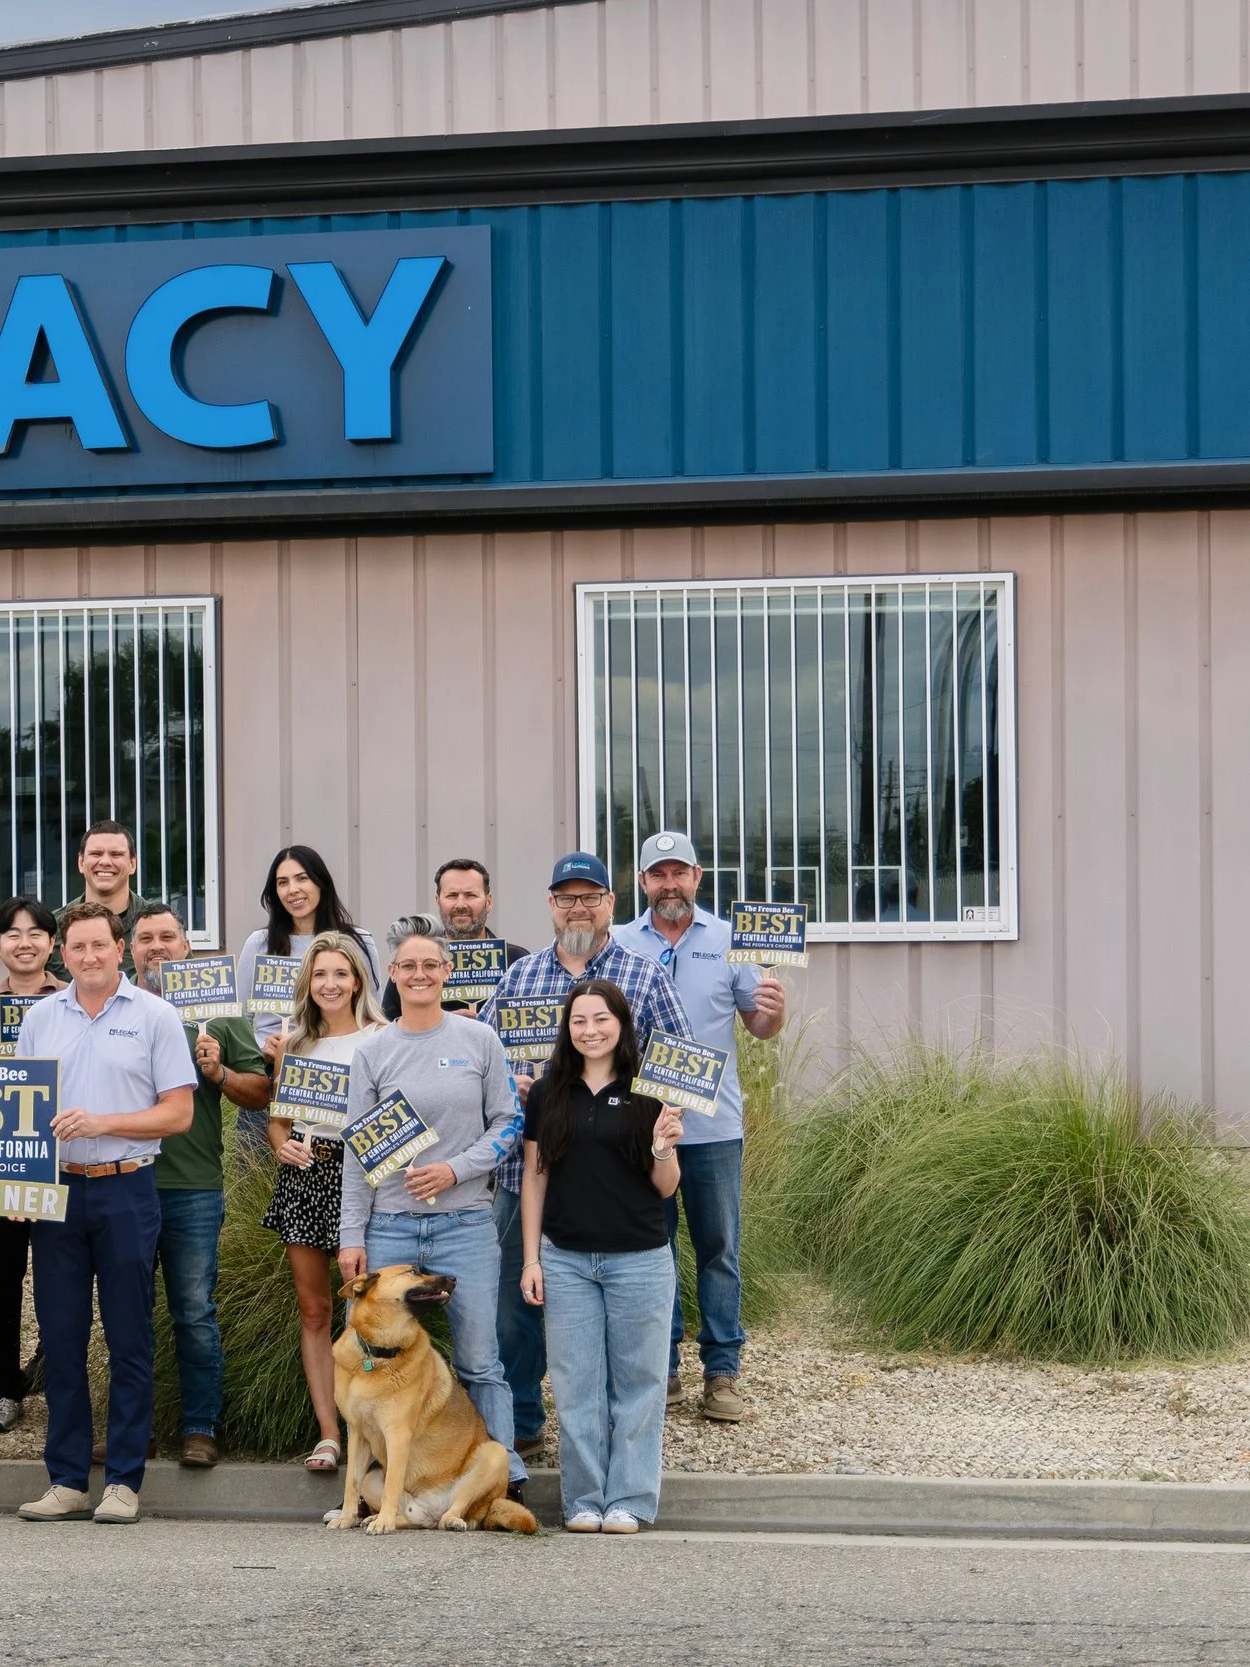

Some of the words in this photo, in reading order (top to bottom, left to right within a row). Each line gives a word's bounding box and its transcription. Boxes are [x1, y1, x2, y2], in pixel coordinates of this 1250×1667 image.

[735, 912, 803, 935] BEST
[743, 934, 767, 942] CENTRAL
[769, 935, 802, 944] CALIFORNIA
[730, 952, 757, 962] 2026
[761, 951, 806, 966] WINNER
[165, 966, 232, 992] BEST
[472, 970, 504, 978] CALIFORNIA
[175, 990, 199, 999] CENTRAL
[201, 987, 234, 997] CALIFORNIA
[264, 985, 286, 993] CENTRAL
[194, 1002, 239, 1017] WINNER
[251, 1001, 276, 1011] 2026
[501, 1031, 507, 1039] OF
[510, 1029, 534, 1038] CENTRAL
[664, 1037, 677, 1046] The
[677, 1041, 701, 1054] Fresno
[702, 1049, 715, 1058] Bee
[295, 1059, 308, 1067] The
[308, 1062, 331, 1071] Fresno
[648, 1041, 722, 1081] BEST
[282, 1065, 350, 1096] BEST
[645, 1063, 653, 1071] OF
[654, 1066, 679, 1080] CENTRAL
[681, 1074, 715, 1091] CALIFORNIA
[281, 1086, 288, 1094] OF
[289, 1088, 313, 1099] CENTRAL
[315, 1092, 348, 1105] CALIFORNIA
[635, 1081, 664, 1097] 2026
[669, 1088, 716, 1115] WINNER
[273, 1105, 301, 1118] 2026
[351, 1123, 363, 1133] The
[362, 1108, 383, 1125] Fresno
[381, 1100, 394, 1110] Bee
[348, 1099, 412, 1157] BEST
[361, 1155, 368, 1164] OF
[368, 1139, 391, 1159] CENTRAL
[389, 1118, 420, 1143] CALIFORNIA
[369, 1160, 395, 1185] 2026
[393, 1128, 436, 1164] WINNER
